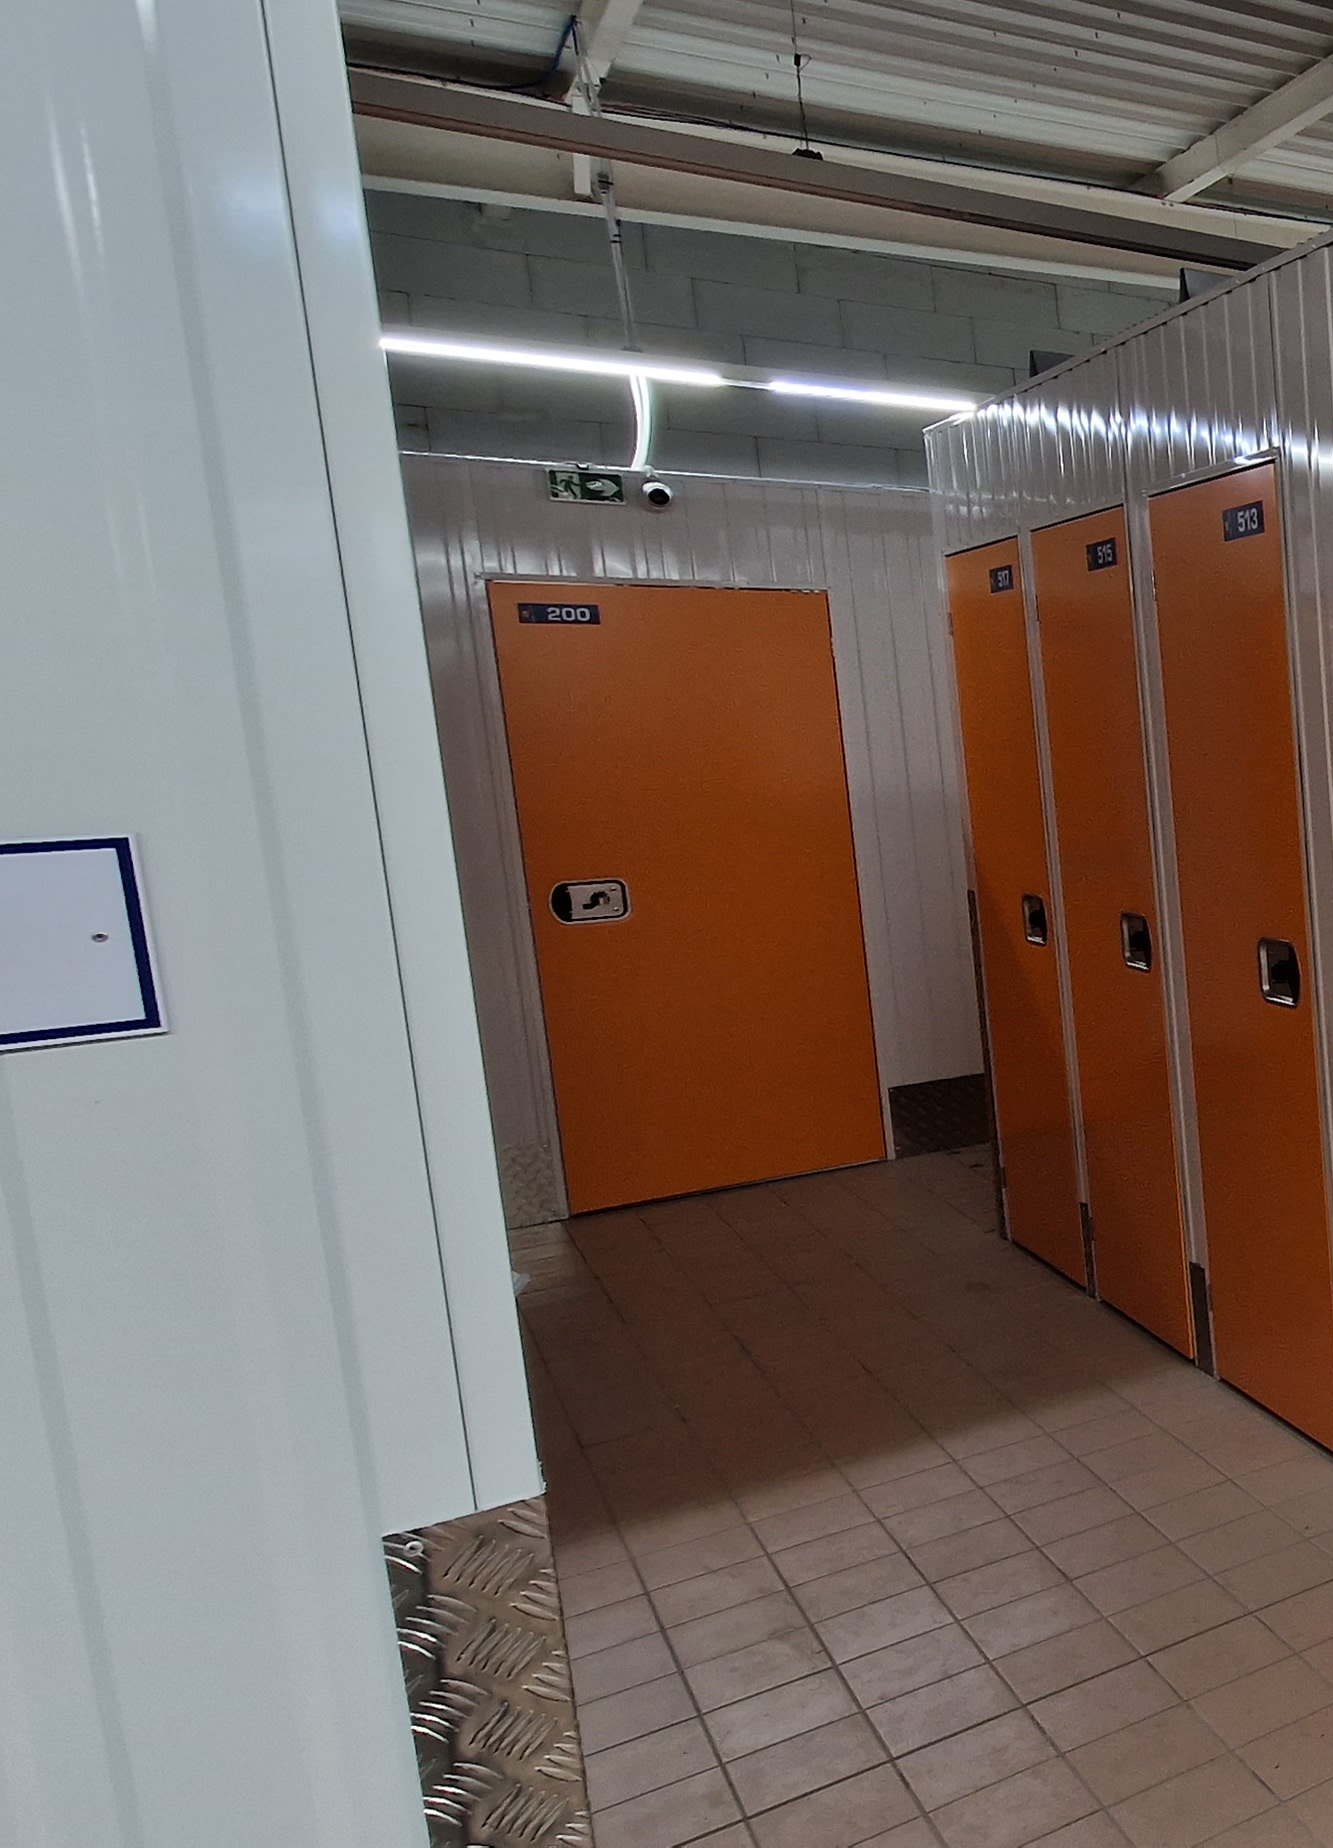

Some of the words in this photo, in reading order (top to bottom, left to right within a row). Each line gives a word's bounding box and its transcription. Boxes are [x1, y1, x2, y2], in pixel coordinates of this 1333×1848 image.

[1237, 507, 1259, 533] 513
[1097, 544, 1113, 564] 515
[546, 606, 591, 622] 200
